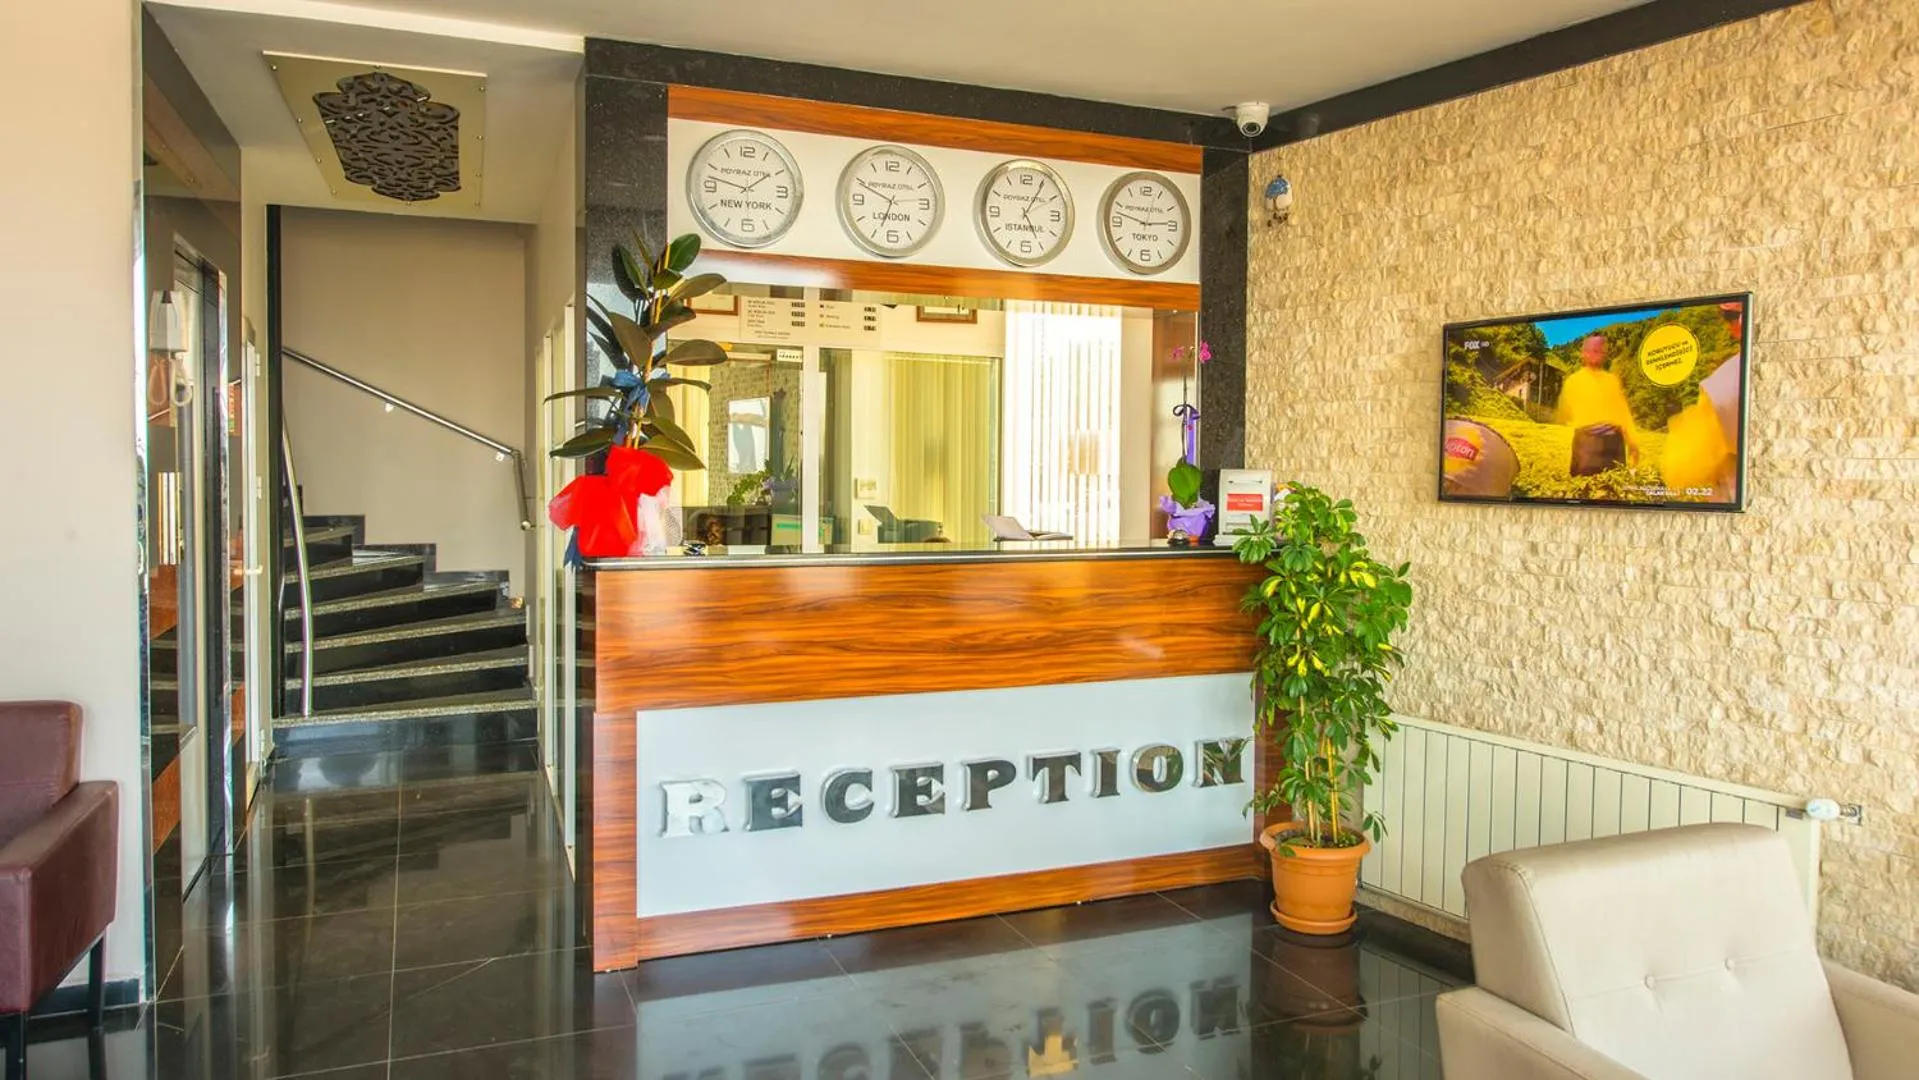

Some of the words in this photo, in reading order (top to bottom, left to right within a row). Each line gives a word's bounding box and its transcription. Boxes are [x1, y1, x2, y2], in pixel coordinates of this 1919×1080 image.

[739, 146, 756, 159] 12
[885, 160, 900, 172] 12
[703, 179, 717, 193] 9
[1020, 174, 1033, 186] 12
[776, 185, 788, 199] 3
[1140, 186, 1152, 197] 12
[720, 199, 743, 209] NEW
[744, 200, 772, 210] YORK
[853, 193, 865, 206] 9
[918, 198, 930, 210] 3
[873, 212, 910, 222] LONDON
[989, 205, 1000, 217] 9
[1050, 210, 1061, 222] 3
[741, 218, 755, 232] 6
[1112, 215, 1123, 228] 9
[1168, 220, 1178, 232] 3
[886, 230, 899, 243] 6
[1131, 233, 1159, 242] TOKYO
[1020, 240, 1032, 253] 6
[1140, 249, 1151, 262] 6
[1464, 340, 1480, 350] FOX
[659, 735, 1250, 838] RECEPTION
